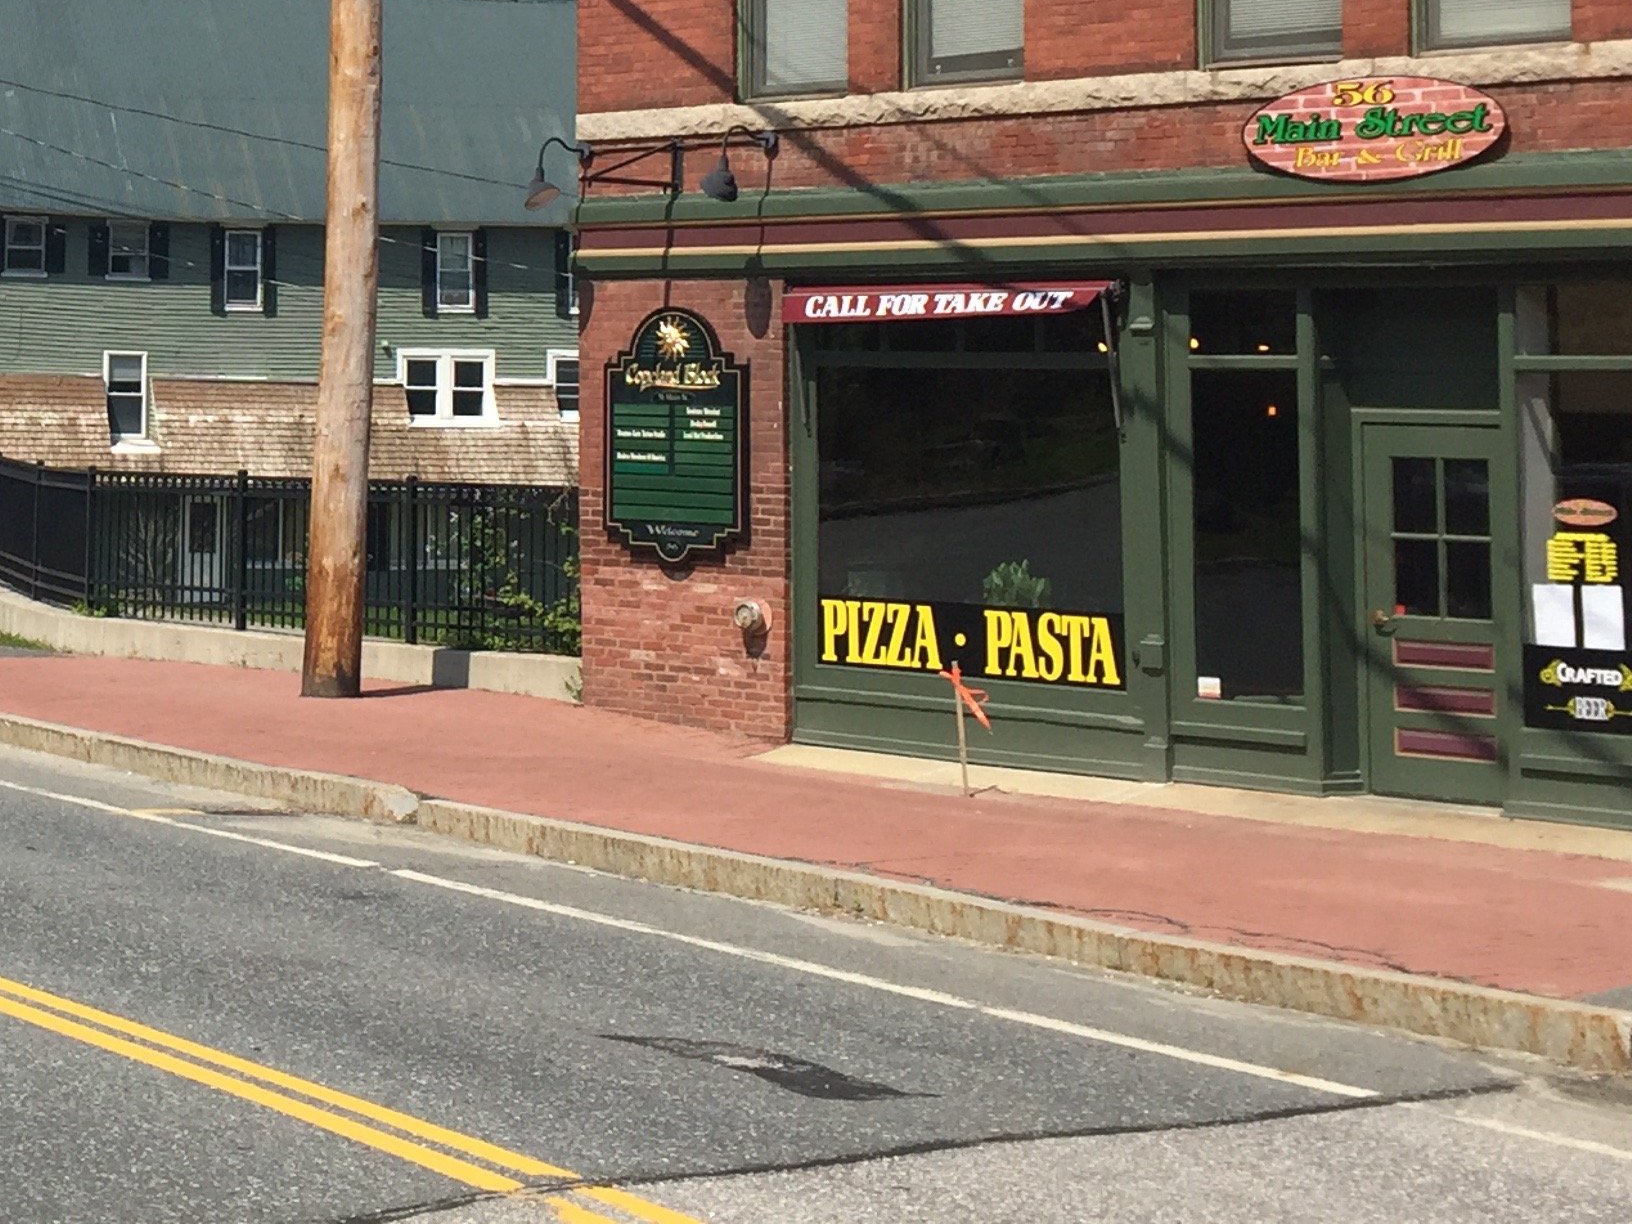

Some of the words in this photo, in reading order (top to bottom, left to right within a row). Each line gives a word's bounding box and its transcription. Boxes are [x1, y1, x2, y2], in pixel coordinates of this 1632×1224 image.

[1332, 80, 1396, 107] 56
[1252, 111, 1343, 146] Main
[1354, 101, 1495, 139] Street
[1294, 146, 1344, 169] Bar
[1355, 148, 1384, 165] &
[1394, 137, 1464, 163] Grill
[804, 294, 871, 318] CALL
[875, 293, 928, 316] FOR
[932, 291, 1009, 315] TAKE
[1011, 290, 1074, 311] OUT
[646, 524, 700, 538] Welcome
[821, 598, 943, 670] PIZZA
[984, 609, 1121, 685] PASTA
[1555, 662, 1624, 686] CRAFTED
